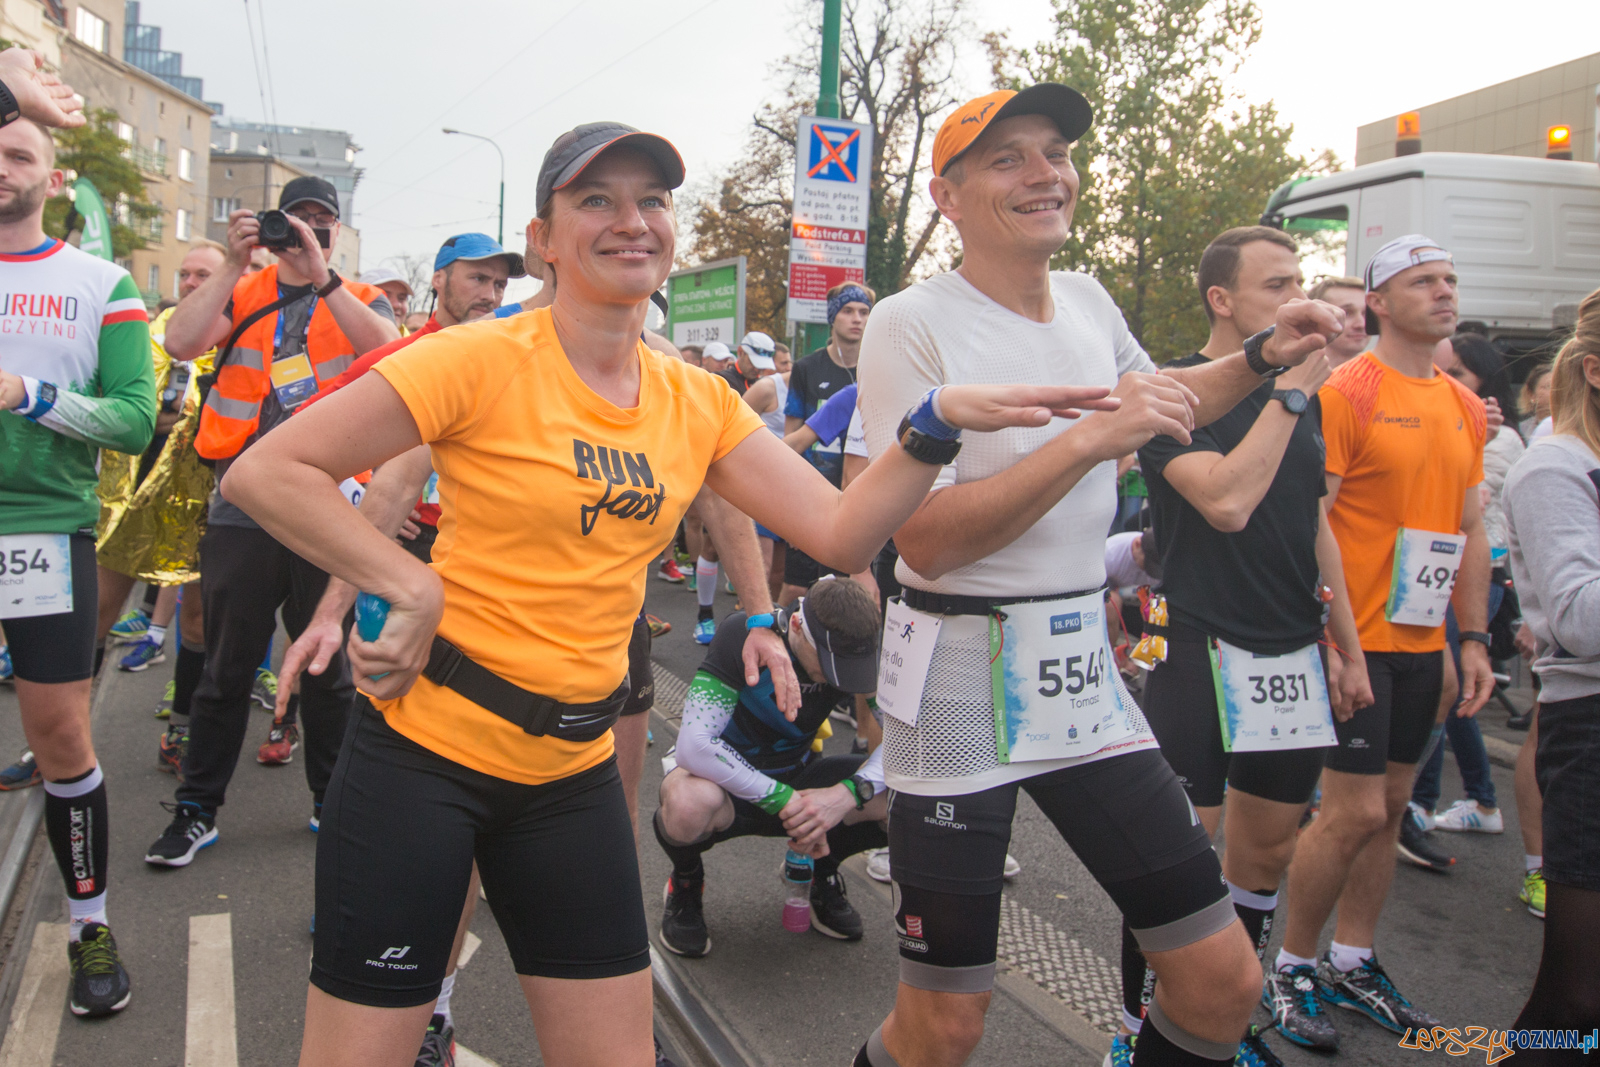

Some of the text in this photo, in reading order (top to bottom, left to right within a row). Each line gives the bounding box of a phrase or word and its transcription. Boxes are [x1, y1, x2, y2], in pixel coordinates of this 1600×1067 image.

[796, 226, 861, 242] Podstrefa A
[824, 243, 852, 253] Parking
[573, 439, 654, 488] RUN
[580, 482, 669, 536] fast
[1053, 617, 1080, 629] 18. PKO
[890, 651, 903, 668] dla
[1248, 673, 1309, 703] 3831
[1070, 694, 1099, 709] Tomasz
[365, 959, 418, 971] PRO TOUCH
